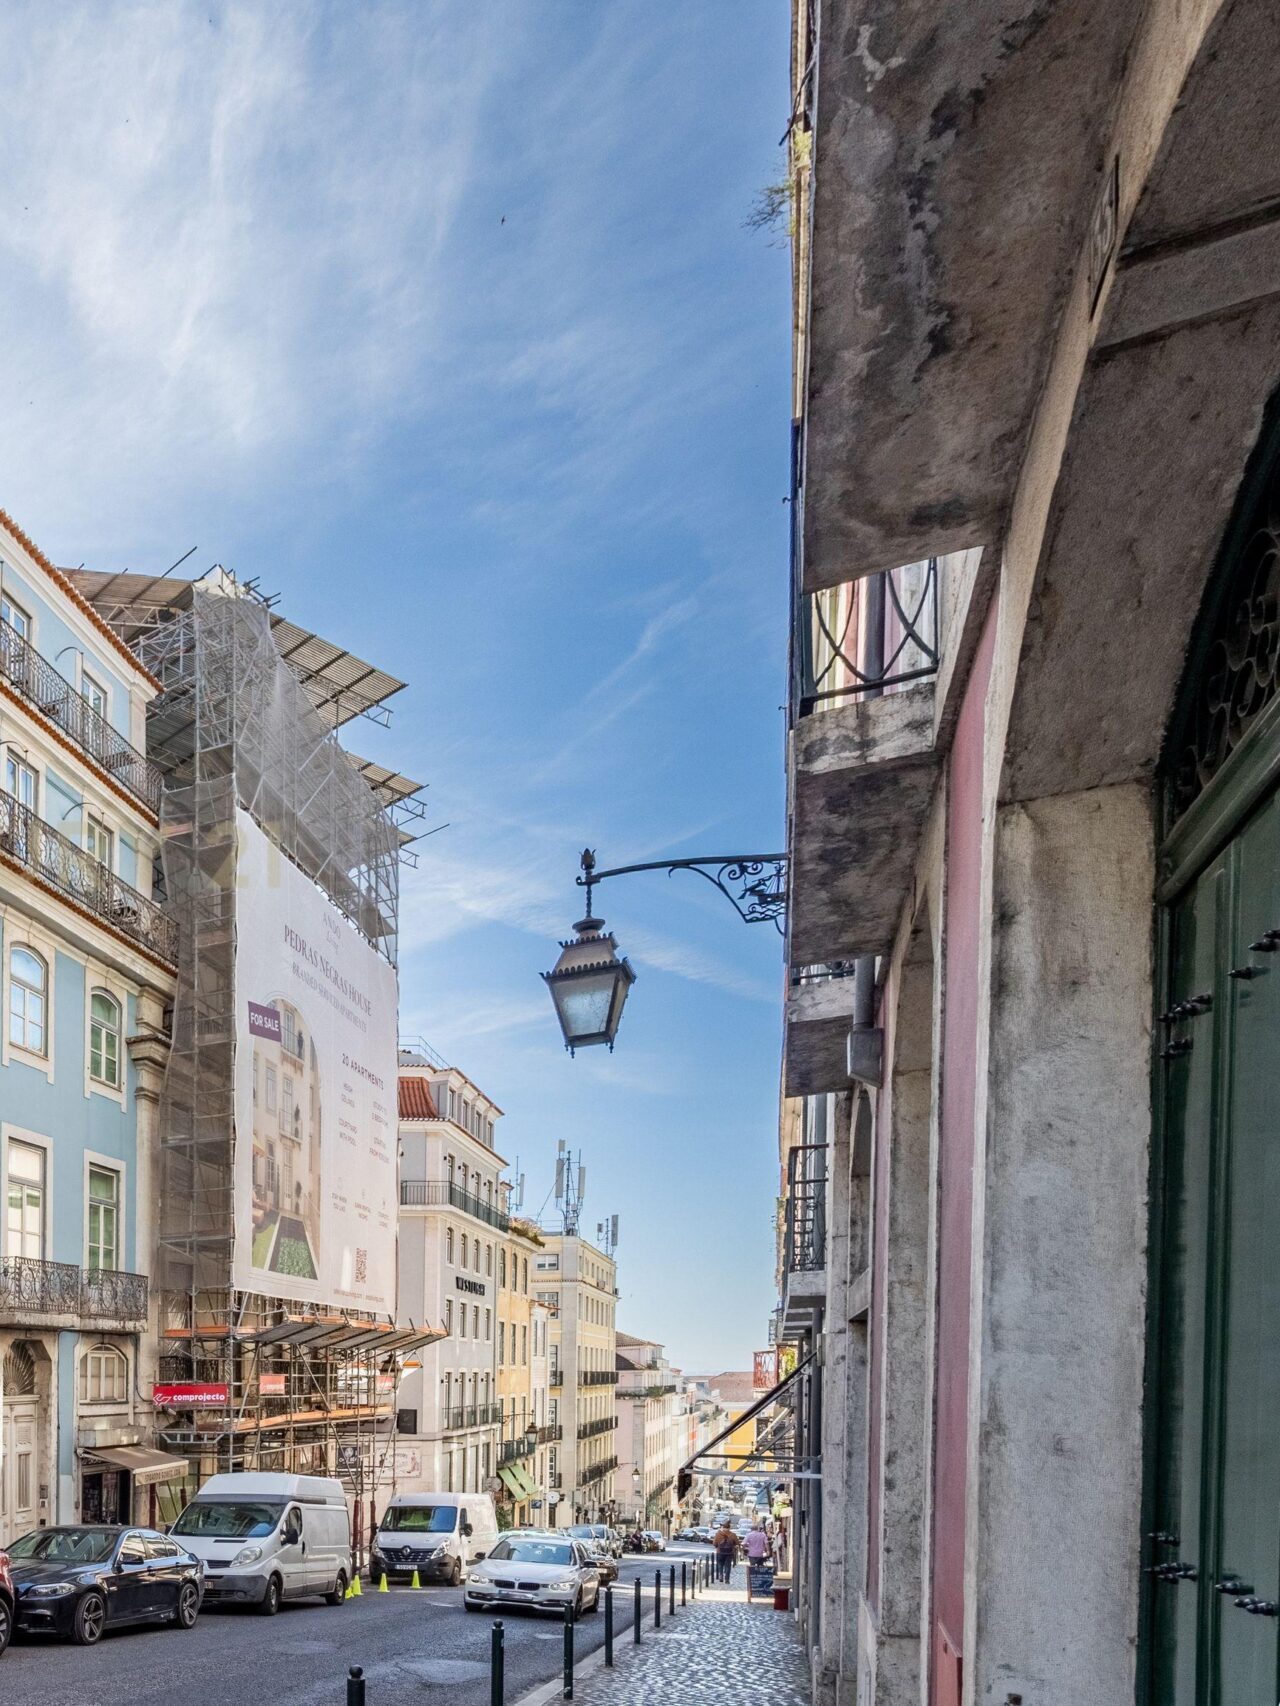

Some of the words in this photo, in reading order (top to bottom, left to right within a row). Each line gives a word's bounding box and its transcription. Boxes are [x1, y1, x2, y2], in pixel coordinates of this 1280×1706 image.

[284, 924, 318, 968] PEDRAS
[320, 955, 348, 996] NEGRAS
[348, 984, 372, 1017] HOUSE
[250, 1012, 263, 1027] FOR
[264, 1016, 279, 1032] SALE
[342, 1052, 350, 1067] 20
[350, 1059, 384, 1091] APARTMENTS
[173, 1392, 225, 1402] comprojecto
